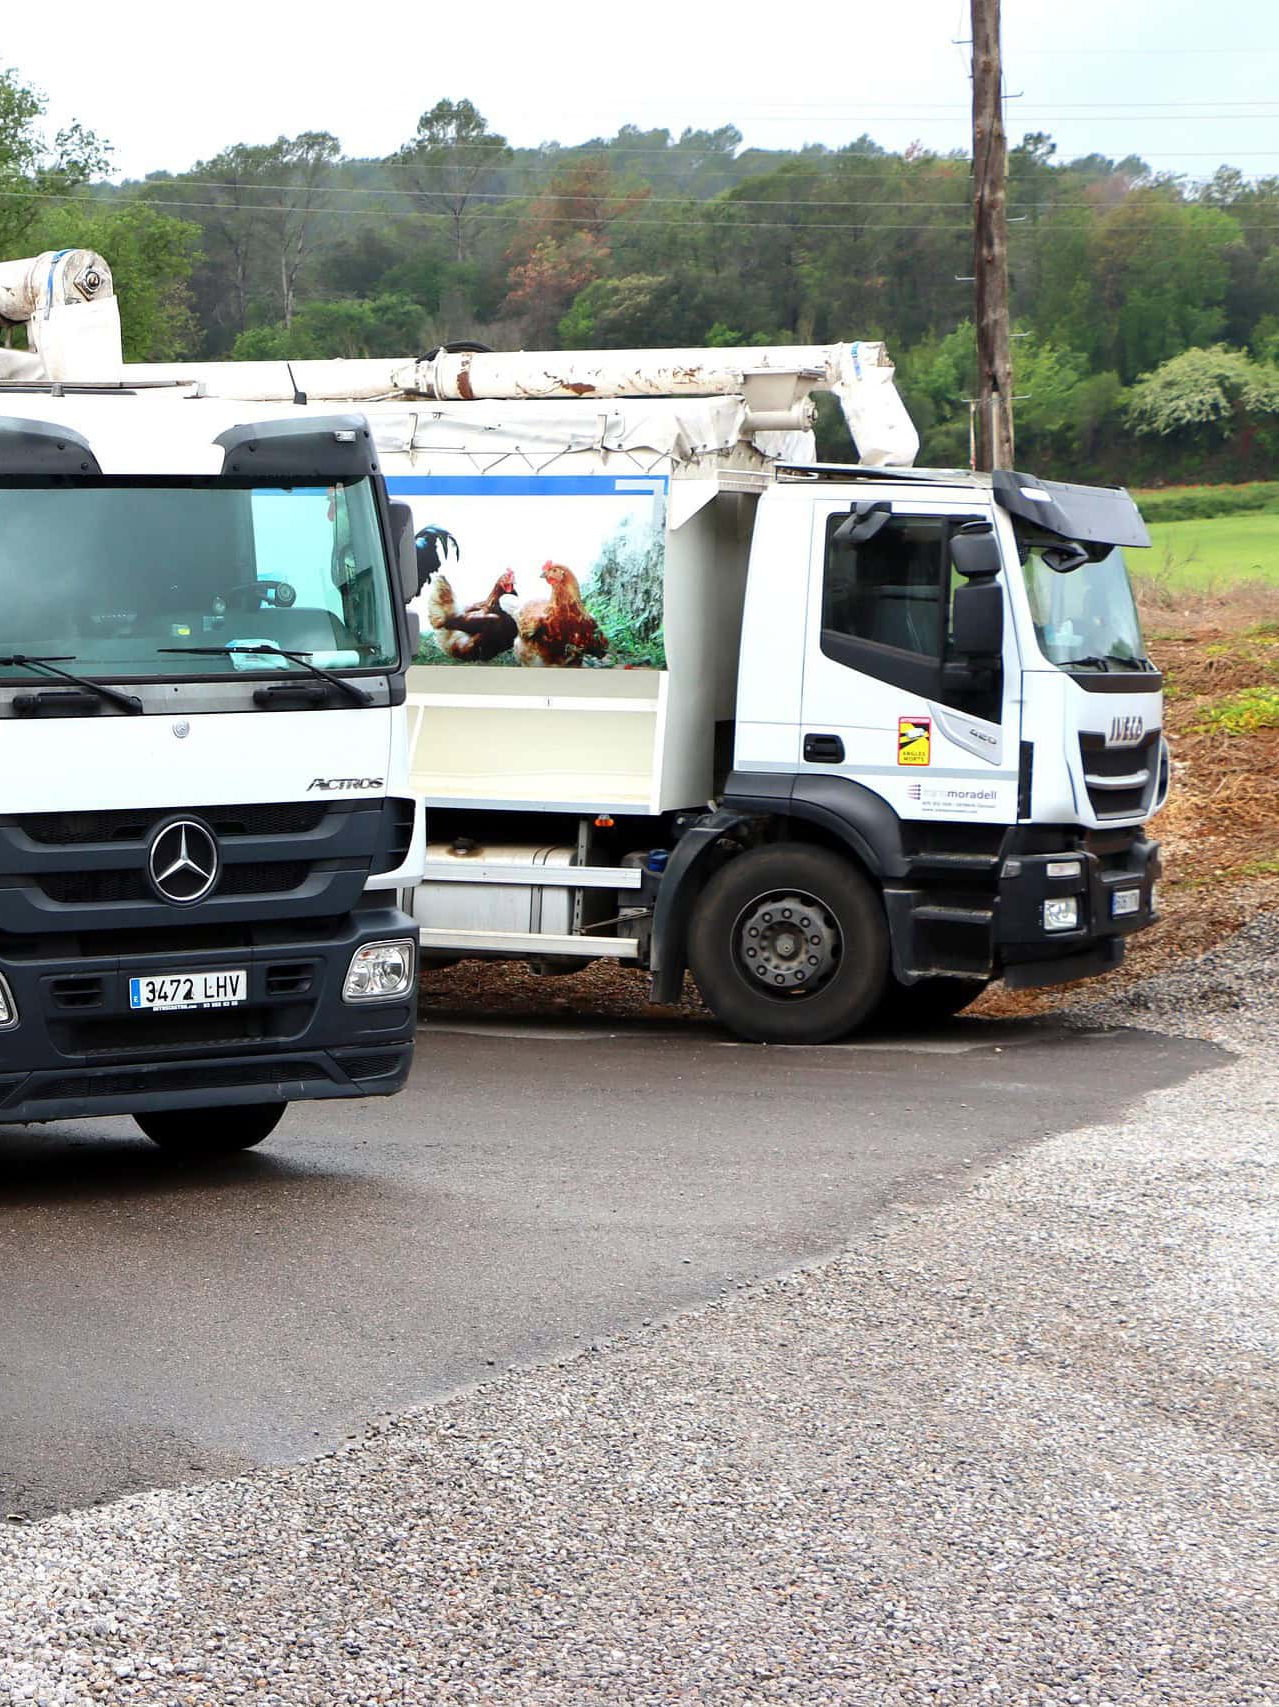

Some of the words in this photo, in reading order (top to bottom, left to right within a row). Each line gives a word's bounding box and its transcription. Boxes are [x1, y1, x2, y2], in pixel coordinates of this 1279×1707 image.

[1109, 716, 1144, 742] IVECO
[305, 777, 385, 792] ACTROS
[145, 978, 194, 1003] 3472
[204, 975, 240, 999] LHV
